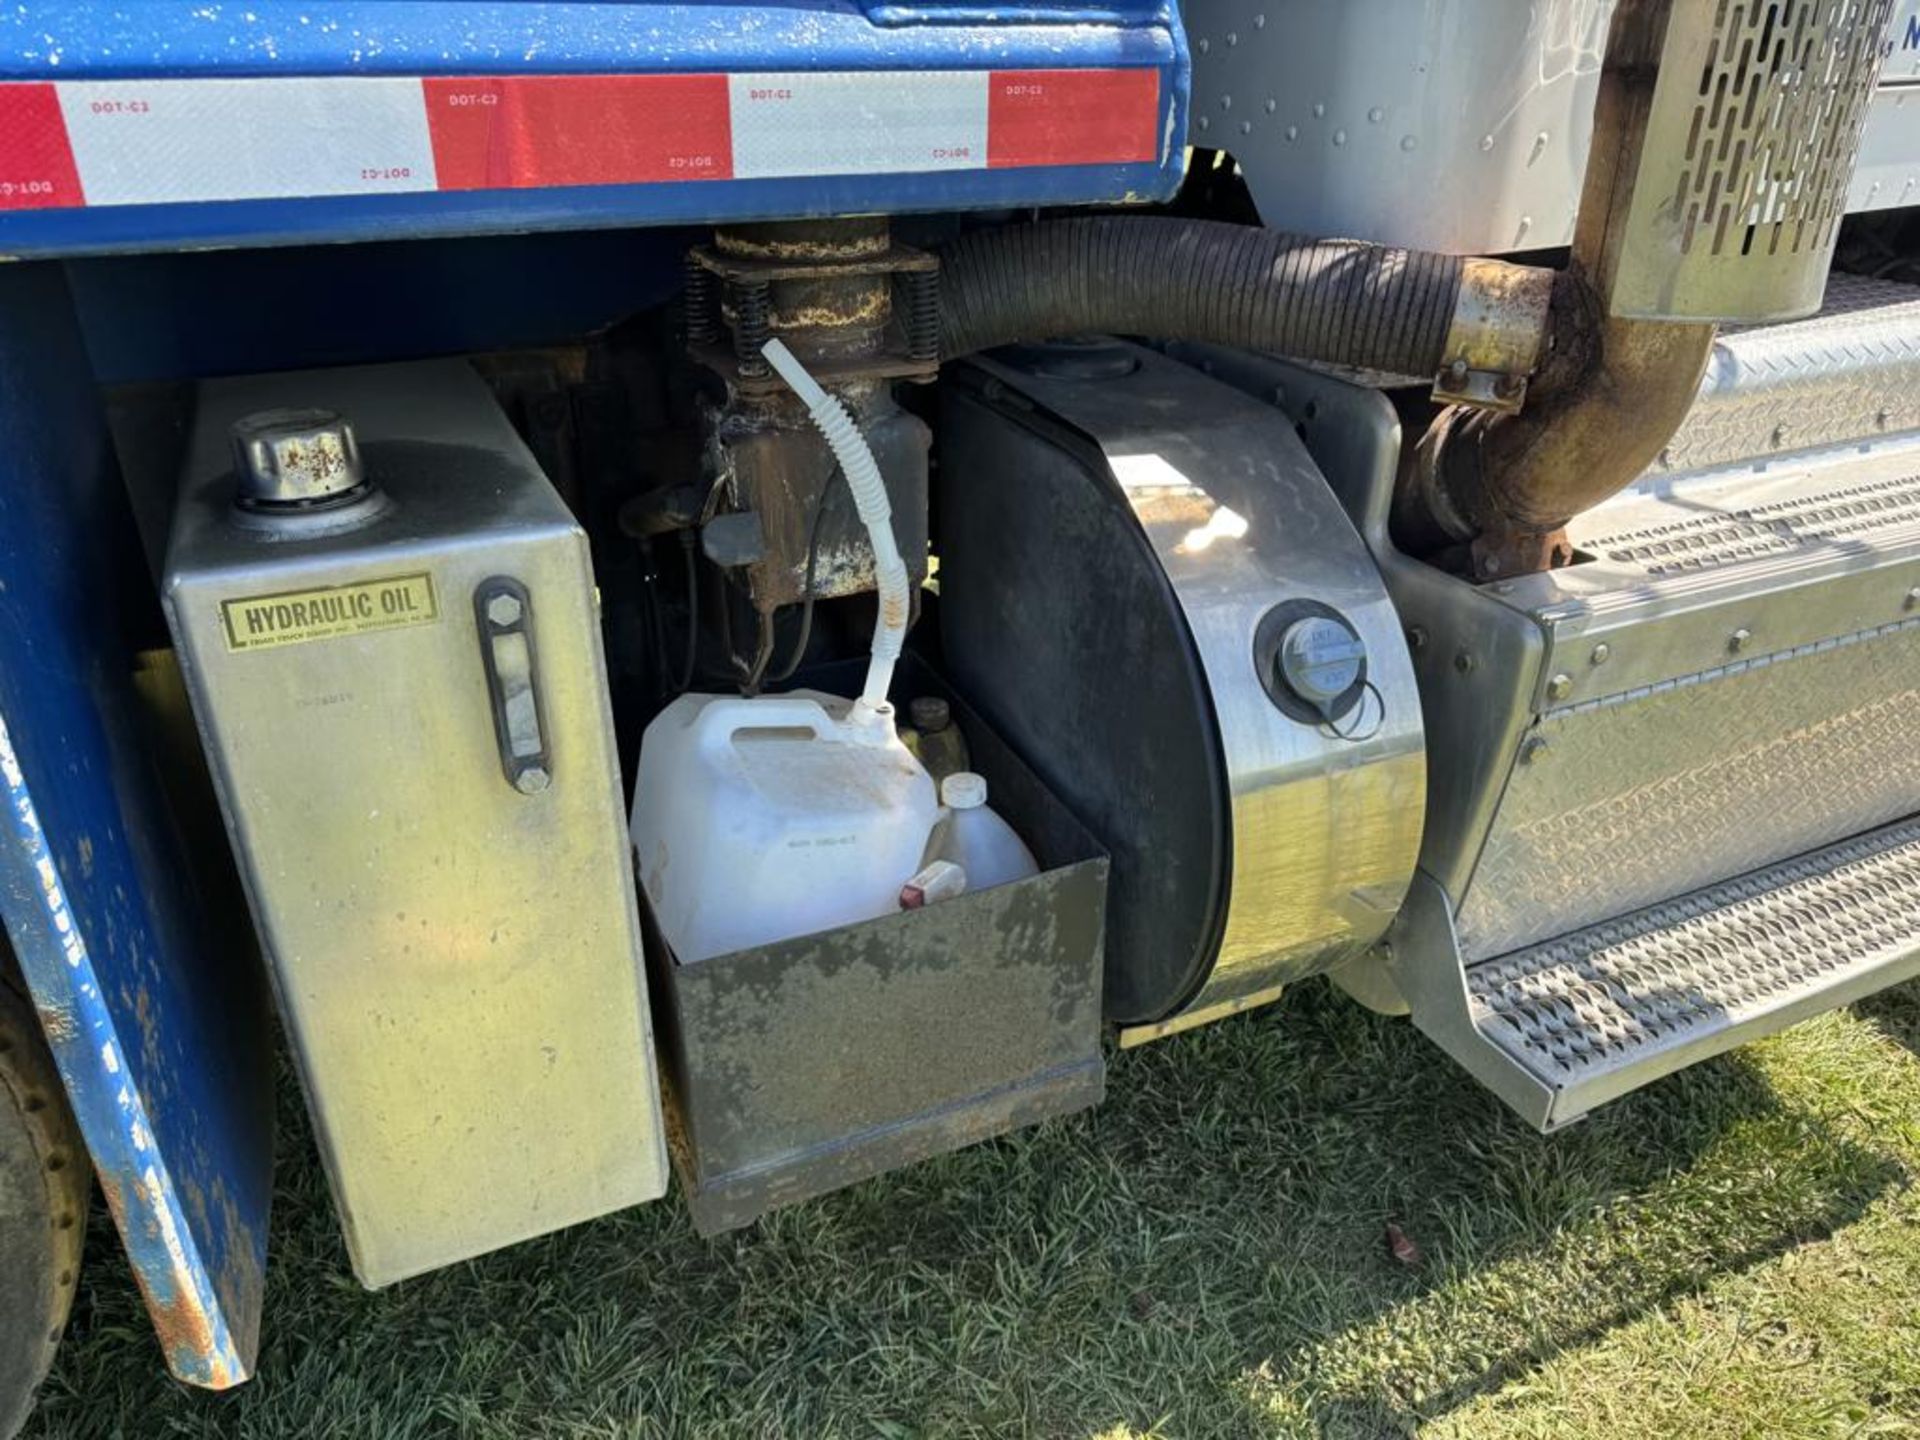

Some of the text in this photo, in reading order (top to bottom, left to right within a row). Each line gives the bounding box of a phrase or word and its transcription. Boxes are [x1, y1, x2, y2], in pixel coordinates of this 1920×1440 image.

[91, 101, 150, 114] DOT-C2
[449, 94, 498, 106] DOT-C2
[0, 180, 53, 197] DOT-C
[244, 593, 373, 635] HYDRAULIC
[380, 586, 419, 614] OIL
